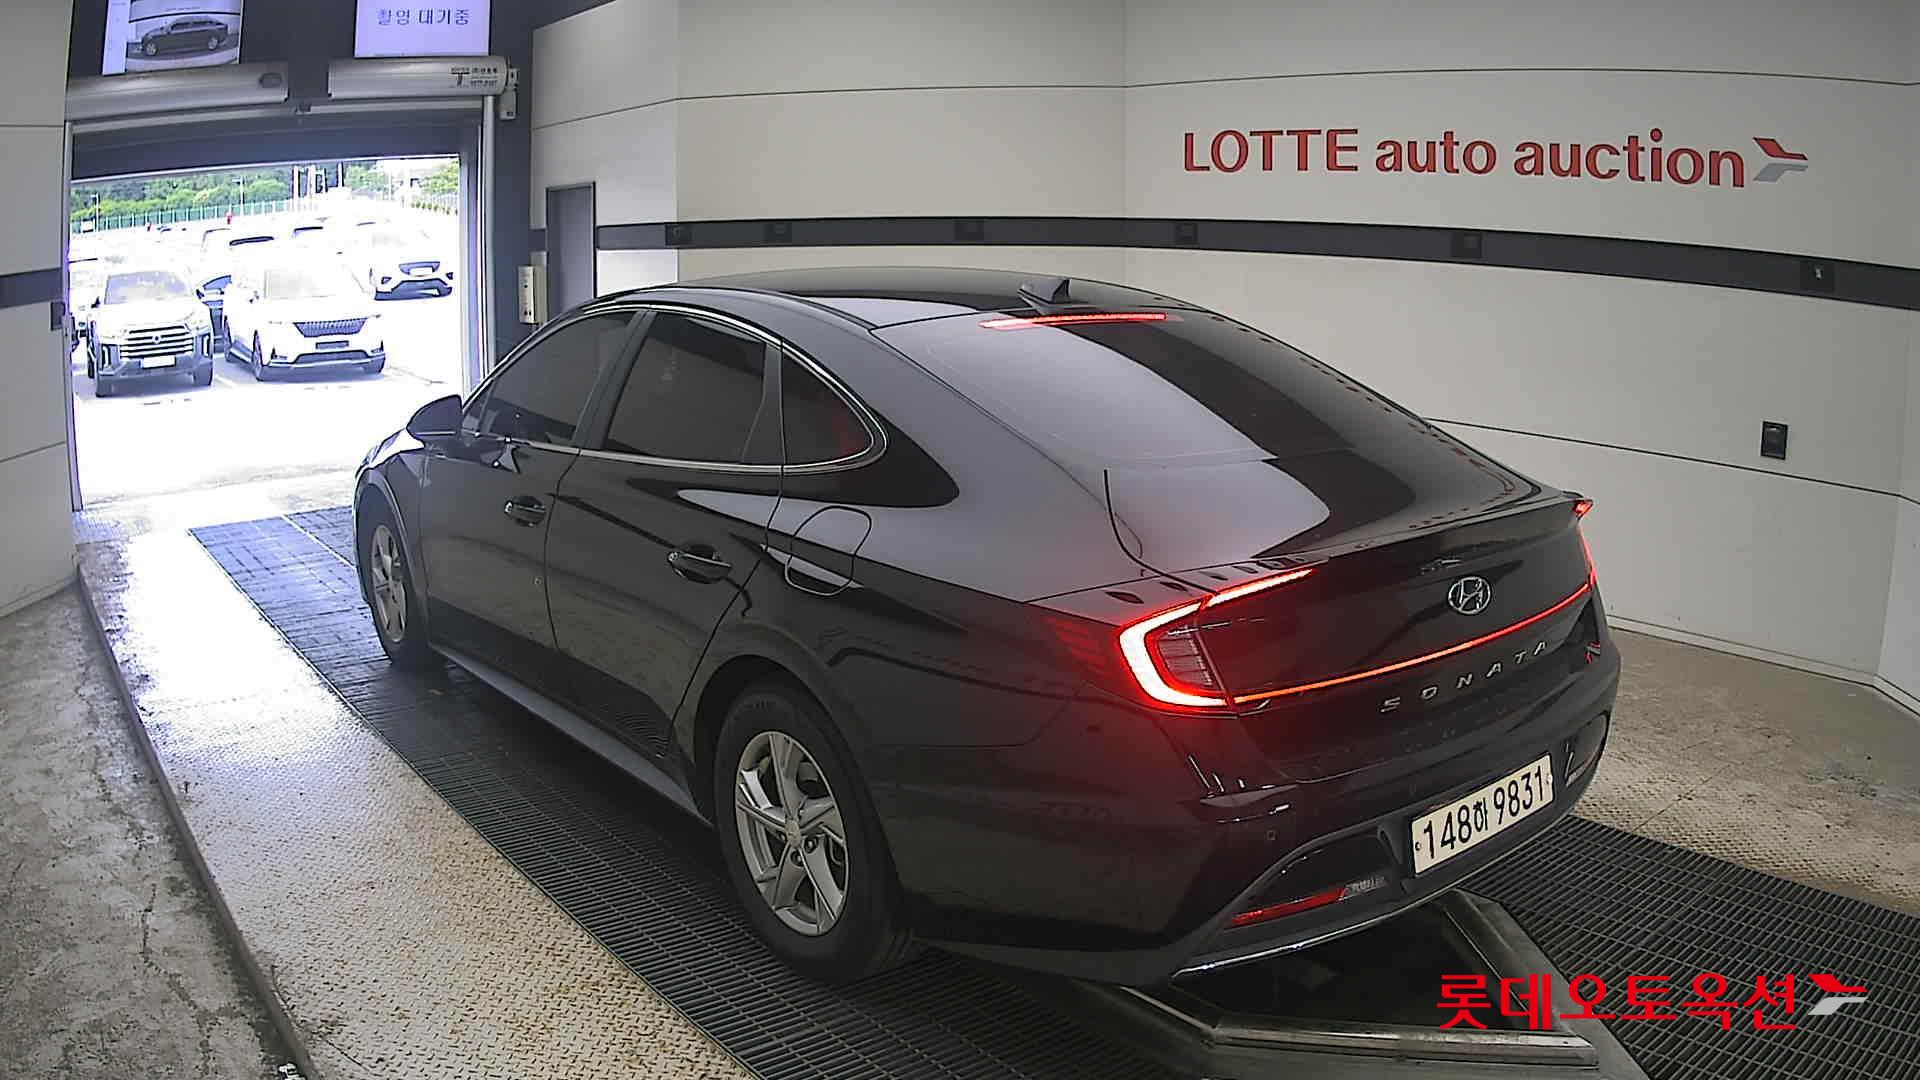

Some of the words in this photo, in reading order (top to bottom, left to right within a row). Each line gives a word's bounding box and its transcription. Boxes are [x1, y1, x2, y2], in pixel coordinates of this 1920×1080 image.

[418, 8, 470, 26] 대기중
[1183, 128, 1359, 173] LOTTE
[1375, 130, 1497, 174] auto
[1513, 127, 1745, 188] auction
[1379, 640, 1548, 713] SONATA
[1423, 796, 1489, 860] 148하
[1493, 764, 1545, 826] 9831
